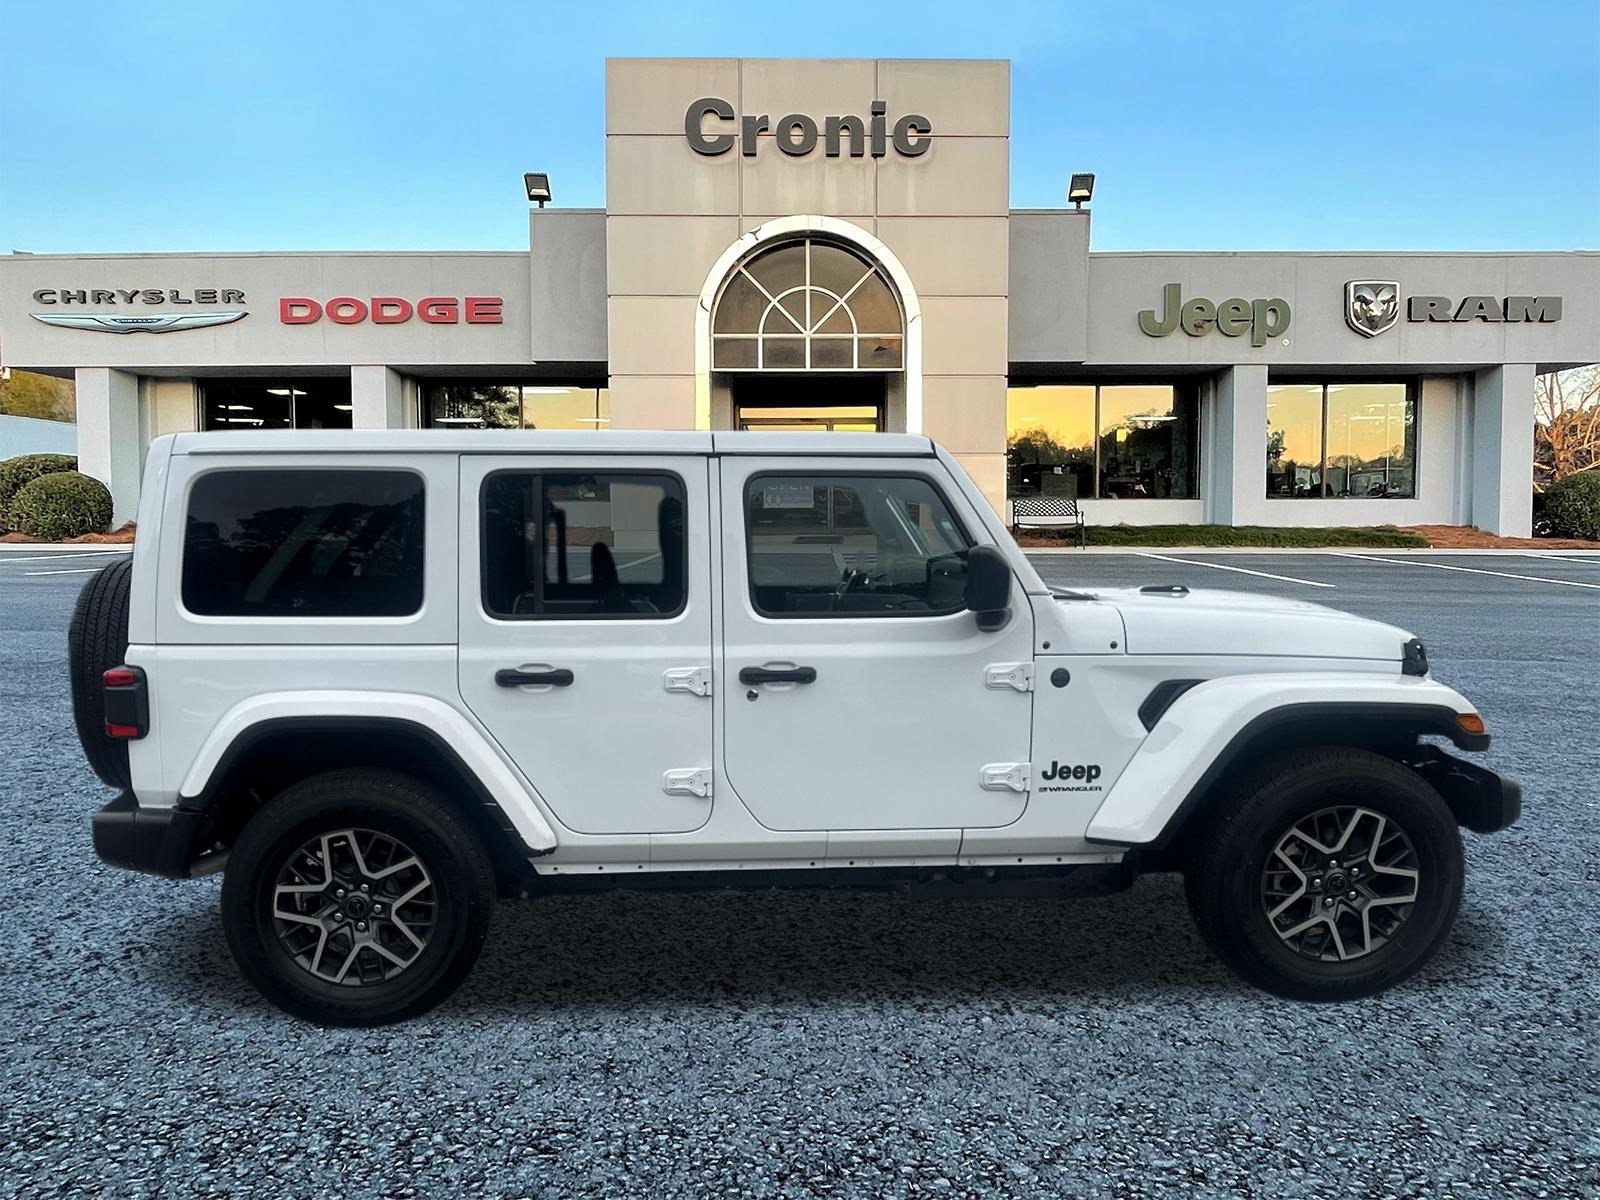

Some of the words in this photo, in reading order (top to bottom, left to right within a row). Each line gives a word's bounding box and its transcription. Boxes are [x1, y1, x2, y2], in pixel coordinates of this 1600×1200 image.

[685, 97, 932, 157] Cronic
[32, 289, 246, 304] CHRYSLER
[1407, 296, 1563, 322] RAM
[279, 297, 504, 324] DODGE
[1138, 283, 1291, 346] Jeep
[1042, 761, 1101, 783] Jeep
